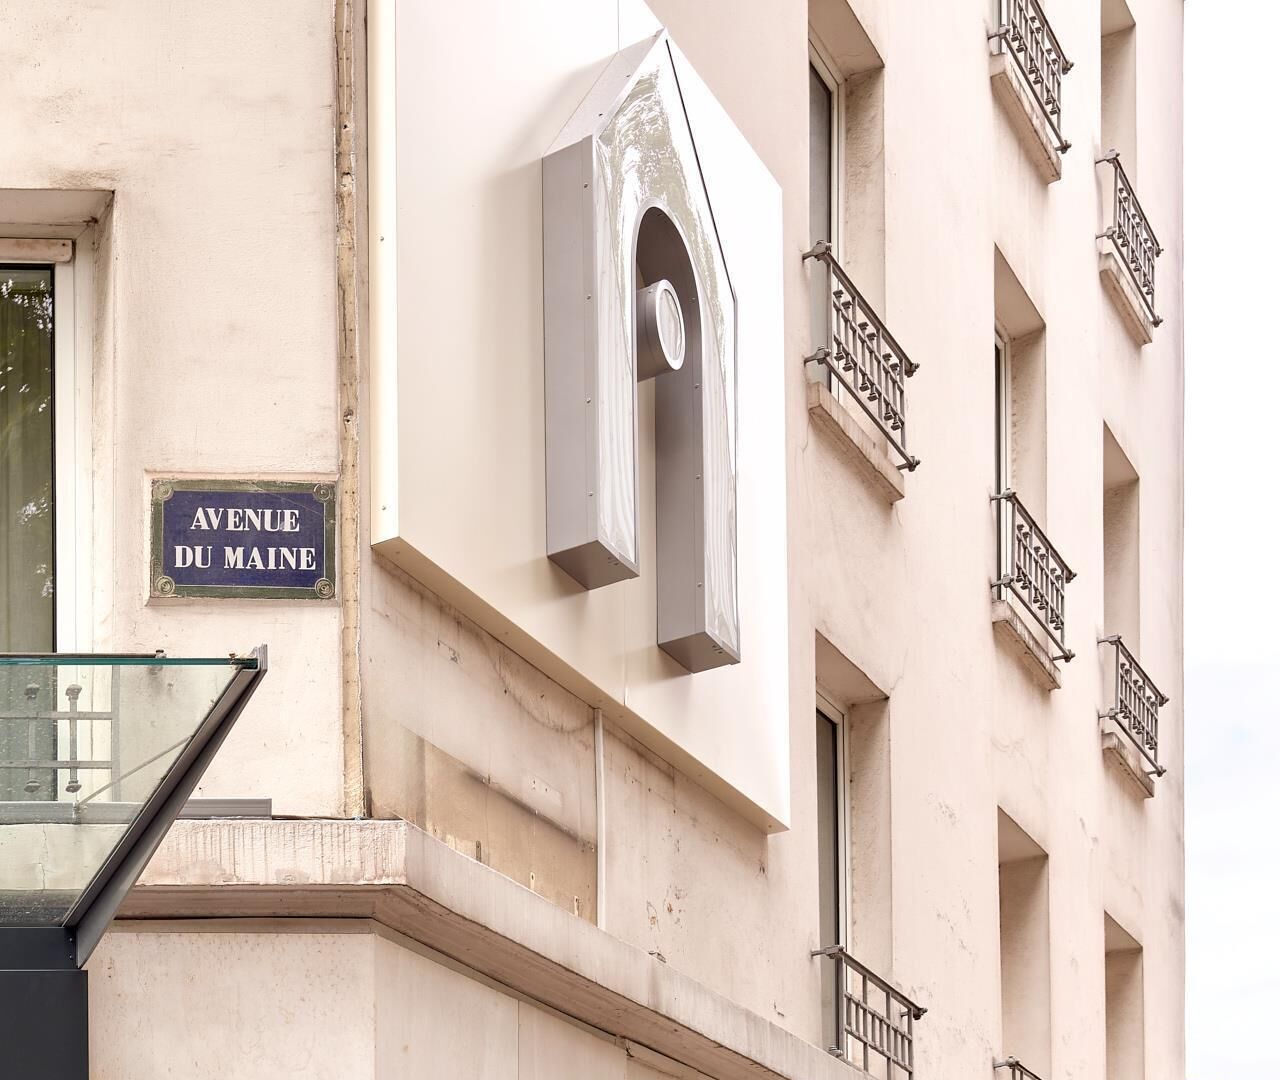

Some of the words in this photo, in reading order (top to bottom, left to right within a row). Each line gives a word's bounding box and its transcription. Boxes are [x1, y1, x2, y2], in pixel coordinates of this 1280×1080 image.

[190, 506, 300, 532] AVENUE
[174, 545, 213, 569] DU
[223, 546, 316, 571] MAINE
